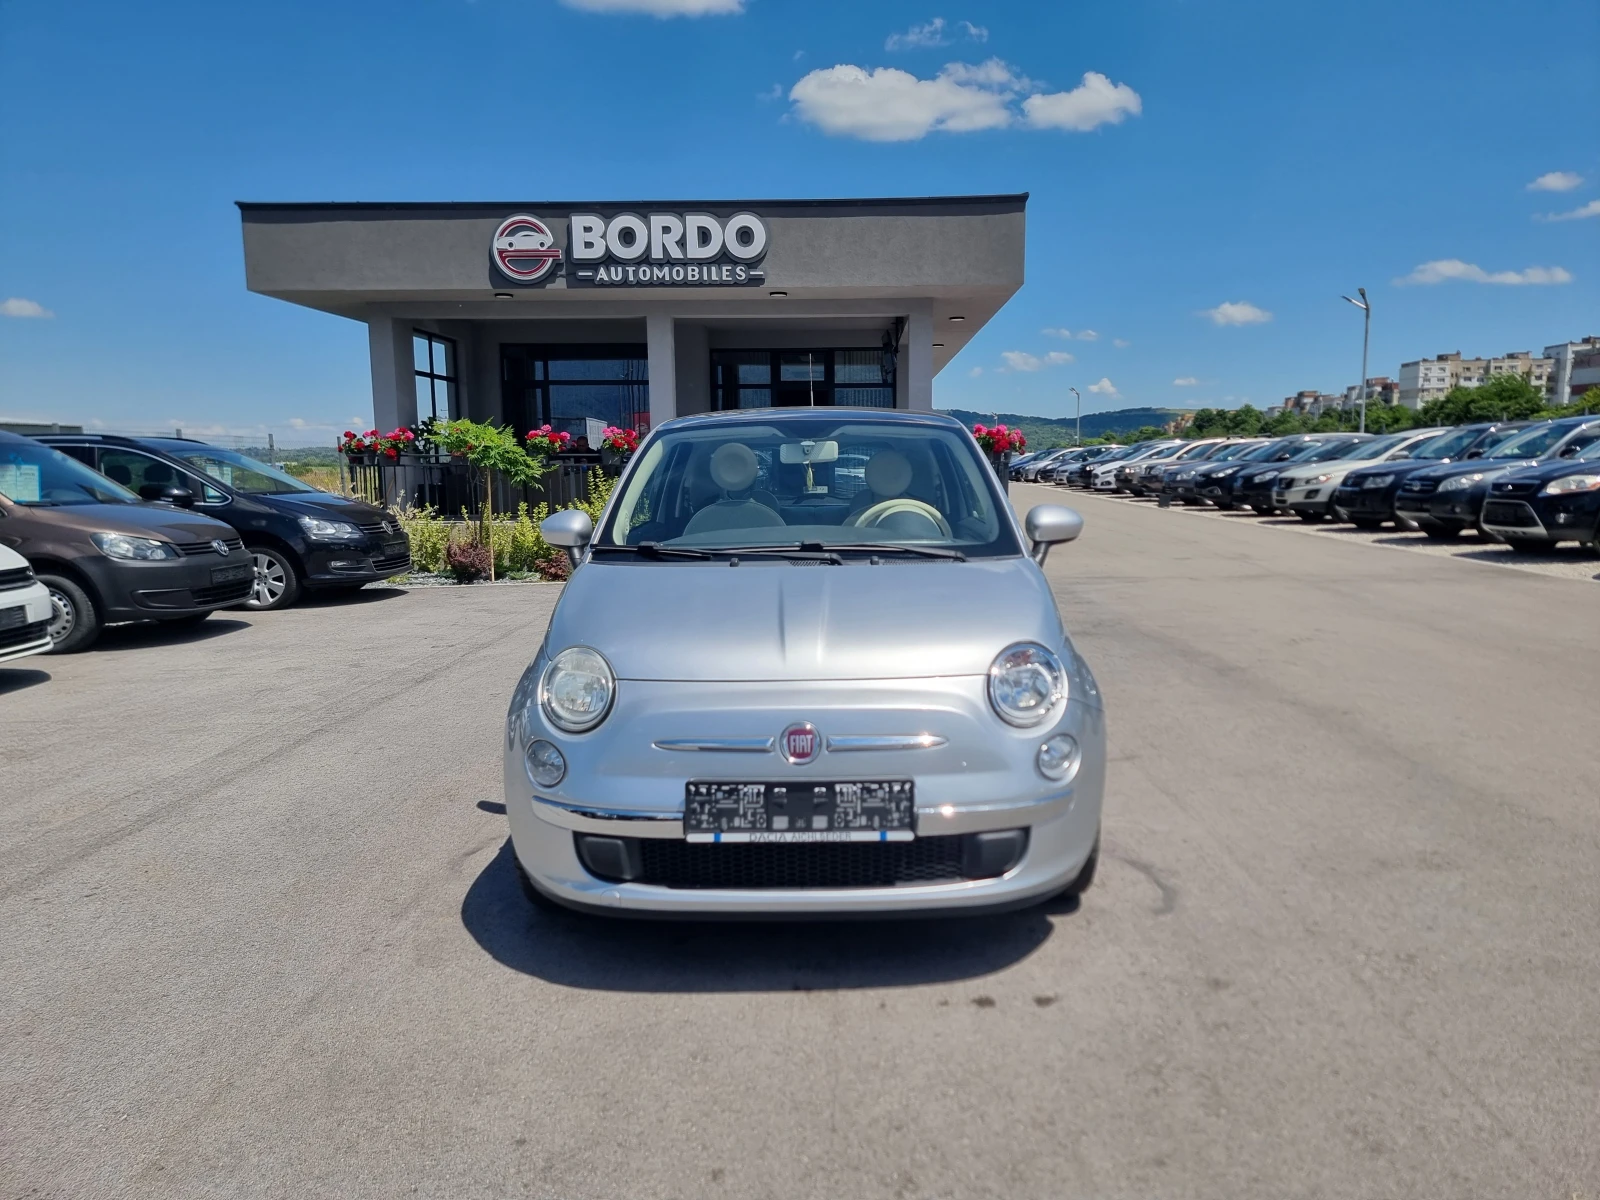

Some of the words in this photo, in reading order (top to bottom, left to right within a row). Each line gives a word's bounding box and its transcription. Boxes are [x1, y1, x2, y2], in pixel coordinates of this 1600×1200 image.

[571, 214, 766, 260] BORDO
[596, 266, 747, 281] AUTOMOBILES
[790, 734, 813, 754] FIAT
[749, 831, 788, 843] DACIA
